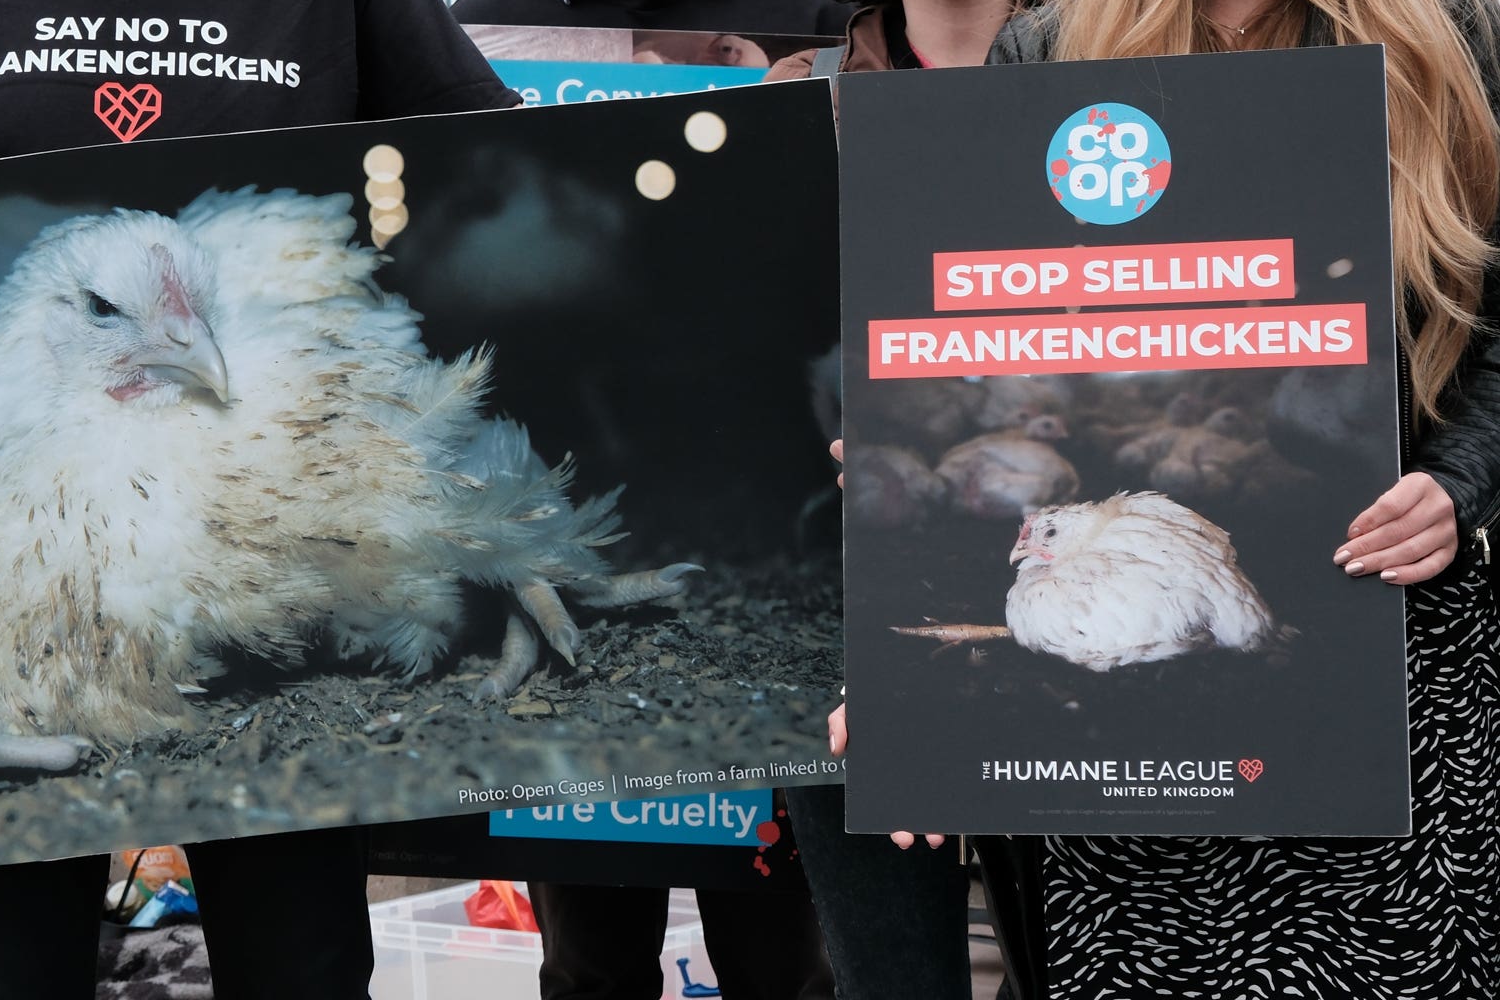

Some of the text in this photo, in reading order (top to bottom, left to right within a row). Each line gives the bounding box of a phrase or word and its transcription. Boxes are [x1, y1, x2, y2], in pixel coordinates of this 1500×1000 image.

[35, 16, 228, 45] SAY NO TO
[1068, 122, 1148, 160] CO
[1068, 162, 1150, 206] OP
[946, 254, 1281, 298] STOP SELLING
[880, 318, 1353, 365] FRANKENCHICKENS
[459, 789, 509, 804] Photo:
[512, 784, 554, 800] Open
[558, 780, 605, 796] Cages
[624, 774, 673, 790] Image
[677, 770, 713, 785] from
[718, 770, 727, 782] a
[729, 765, 766, 781] farm
[770, 760, 817, 777] linked
[821, 760, 838, 774] to
[982, 760, 1234, 781] THE HUMANE LEAGUE
[1103, 787, 1234, 797] UNITED KINGDOM
[610, 792, 758, 839] Cruelty
